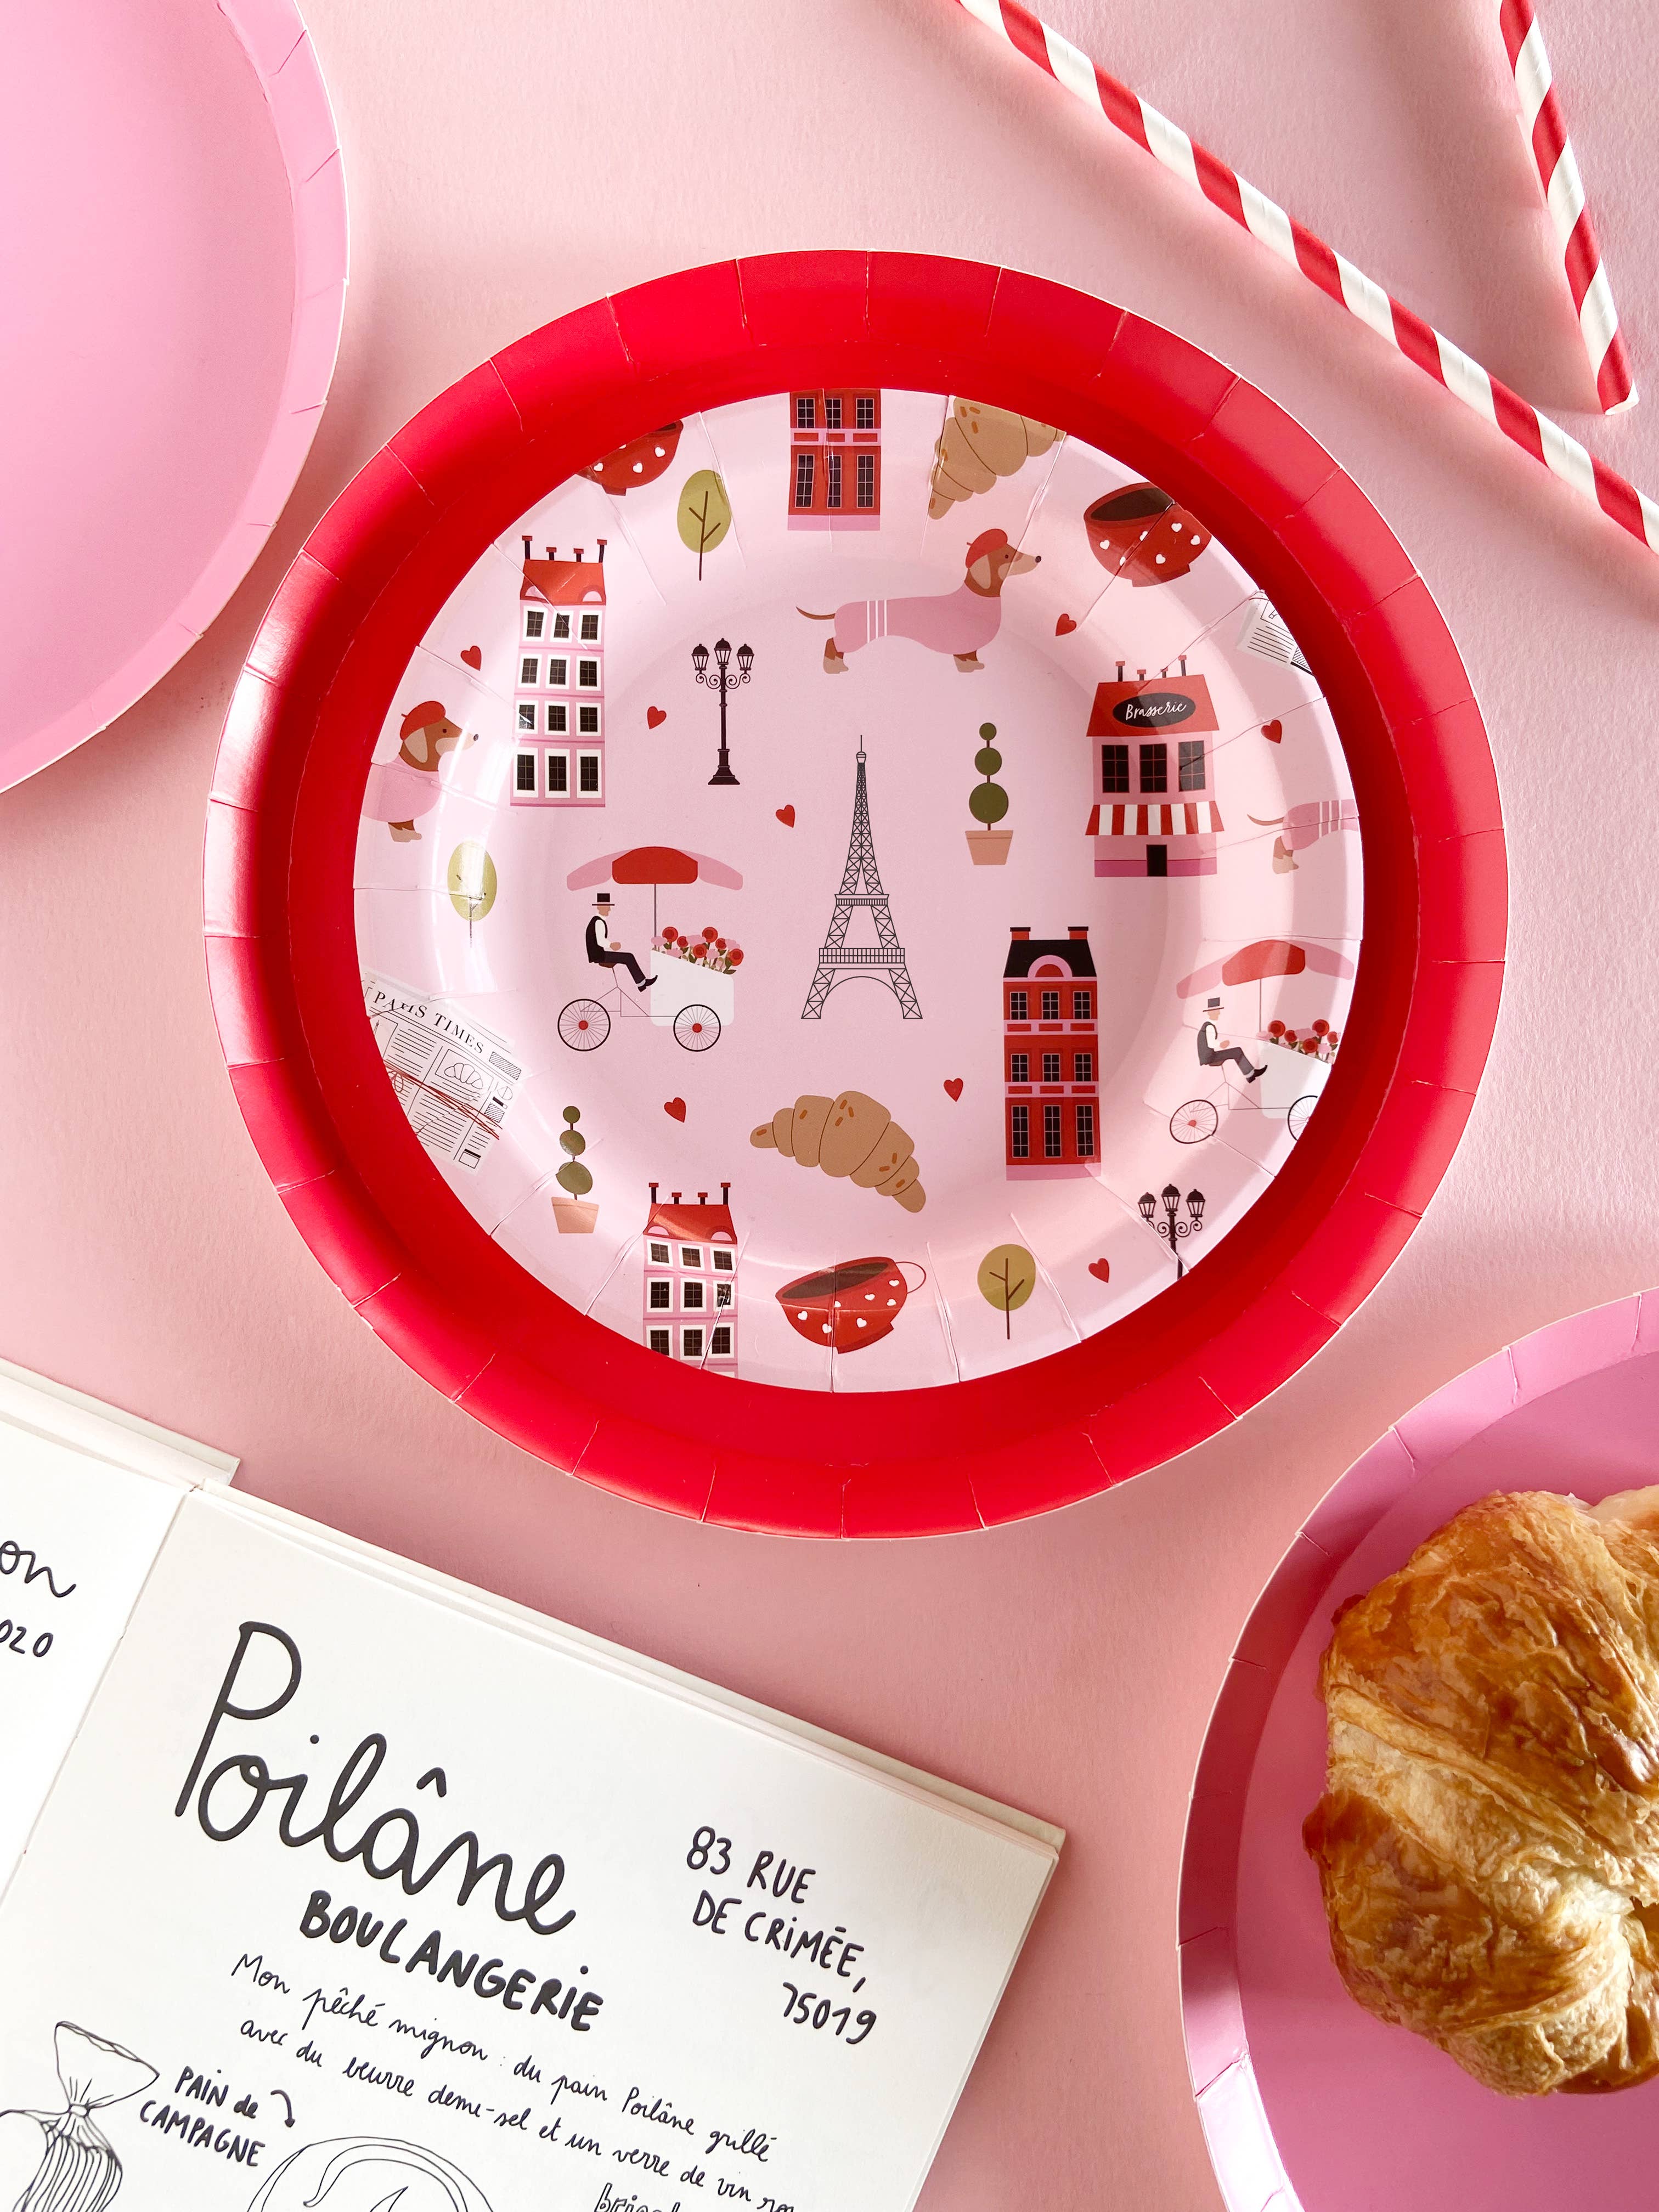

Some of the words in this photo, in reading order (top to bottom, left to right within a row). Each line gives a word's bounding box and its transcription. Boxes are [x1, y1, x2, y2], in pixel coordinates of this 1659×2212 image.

[1126, 701, 1187, 721] Brasserie
[434, 1013, 484, 1054] TIMES
[175, 1621, 577, 1936] Poilâne
[686, 1826, 732, 1875] 83
[747, 1850, 816, 1904] RUE
[692, 1890, 742, 1934] DE
[782, 1982, 877, 2045] 75019
[231, 1954, 290, 1994] Mon
[302, 1987, 386, 2030] pêché
[388, 2017, 488, 2061] mignon
[514, 2055, 541, 2083] du
[550, 2075, 607, 2105] pain
[622, 2086, 695, 2135] Poilâne
[705, 2129, 777, 2162] grillé
[174, 2066, 229, 2107] PAIN
[233, 2094, 258, 2119] de
[240, 2020, 288, 2046] avec
[296, 2040, 322, 2068] du
[342, 2057, 414, 2097] beurre
[428, 2084, 531, 2130] demi-sel
[539, 2117, 561, 2142] et
[565, 2134, 602, 2155] un
[612, 2149, 670, 2177] verre
[680, 2165, 706, 2187] de
[718, 2172, 752, 2202] vin
[140, 2100, 266, 2167] CAMPAGNE
